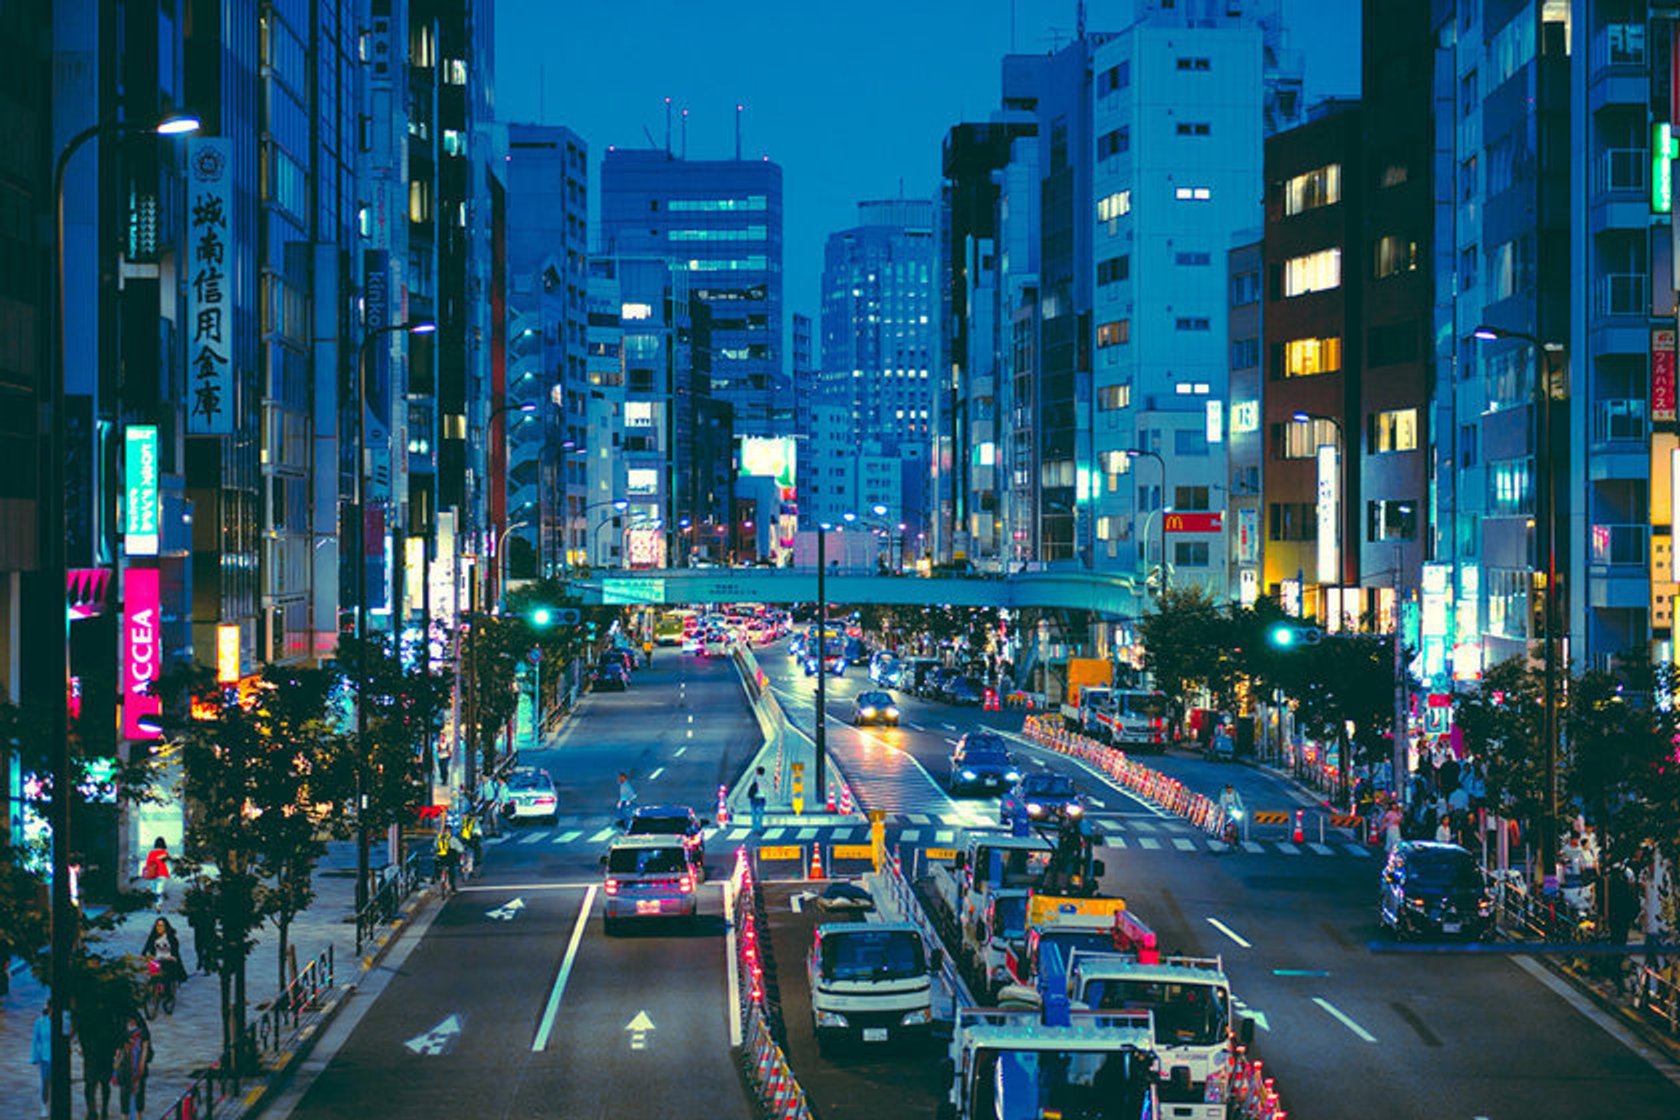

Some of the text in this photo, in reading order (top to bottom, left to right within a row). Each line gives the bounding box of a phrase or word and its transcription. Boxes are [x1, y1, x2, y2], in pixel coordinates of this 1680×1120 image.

[192, 193, 228, 425] 城南信用金庫
[1655, 351, 1667, 408] フルハウス
[131, 608, 153, 698] ACCEA
